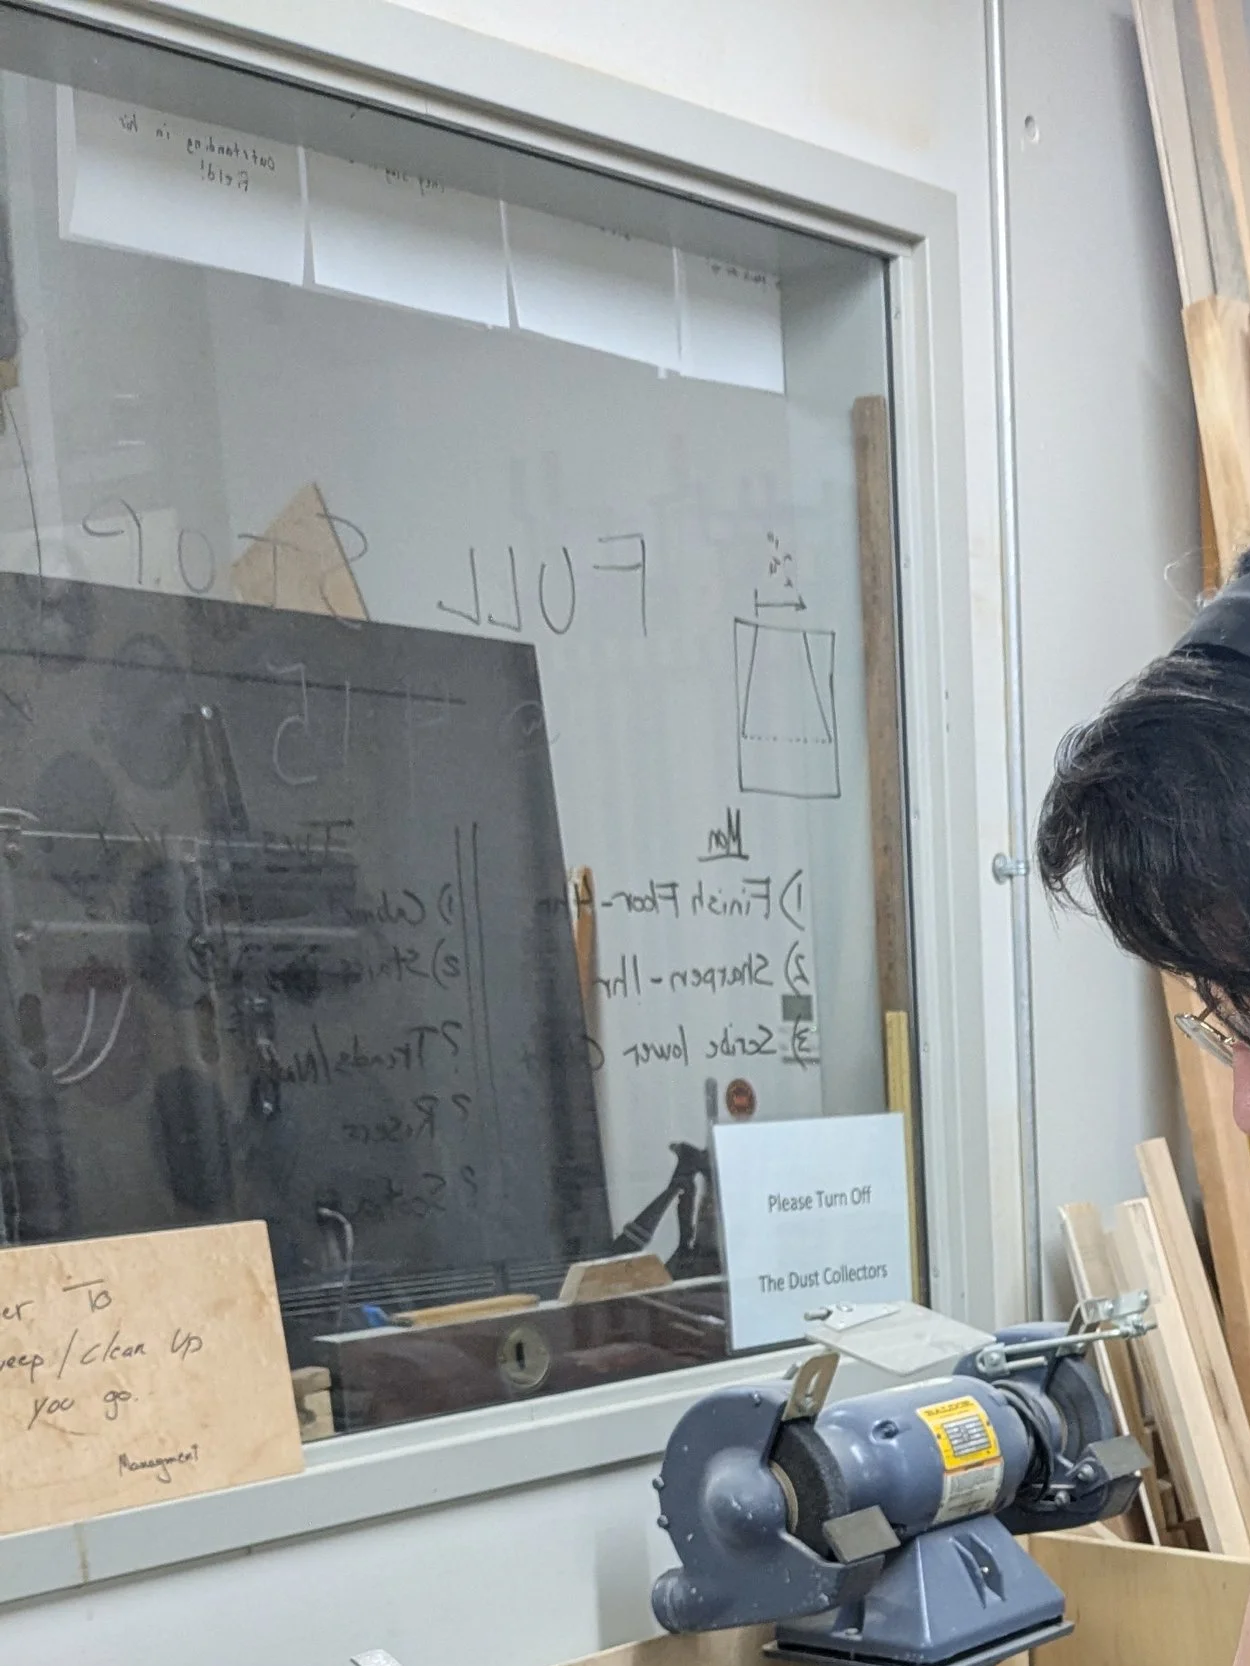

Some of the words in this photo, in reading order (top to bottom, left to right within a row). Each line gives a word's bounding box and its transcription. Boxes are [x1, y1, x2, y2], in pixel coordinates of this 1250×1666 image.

[767, 1193, 813, 1213] Please
[816, 1190, 848, 1209] Turn
[850, 1185, 872, 1205] Off
[758, 1274, 785, 1293] The
[789, 1270, 819, 1289] Dust
[823, 1263, 888, 1286] Collectors
